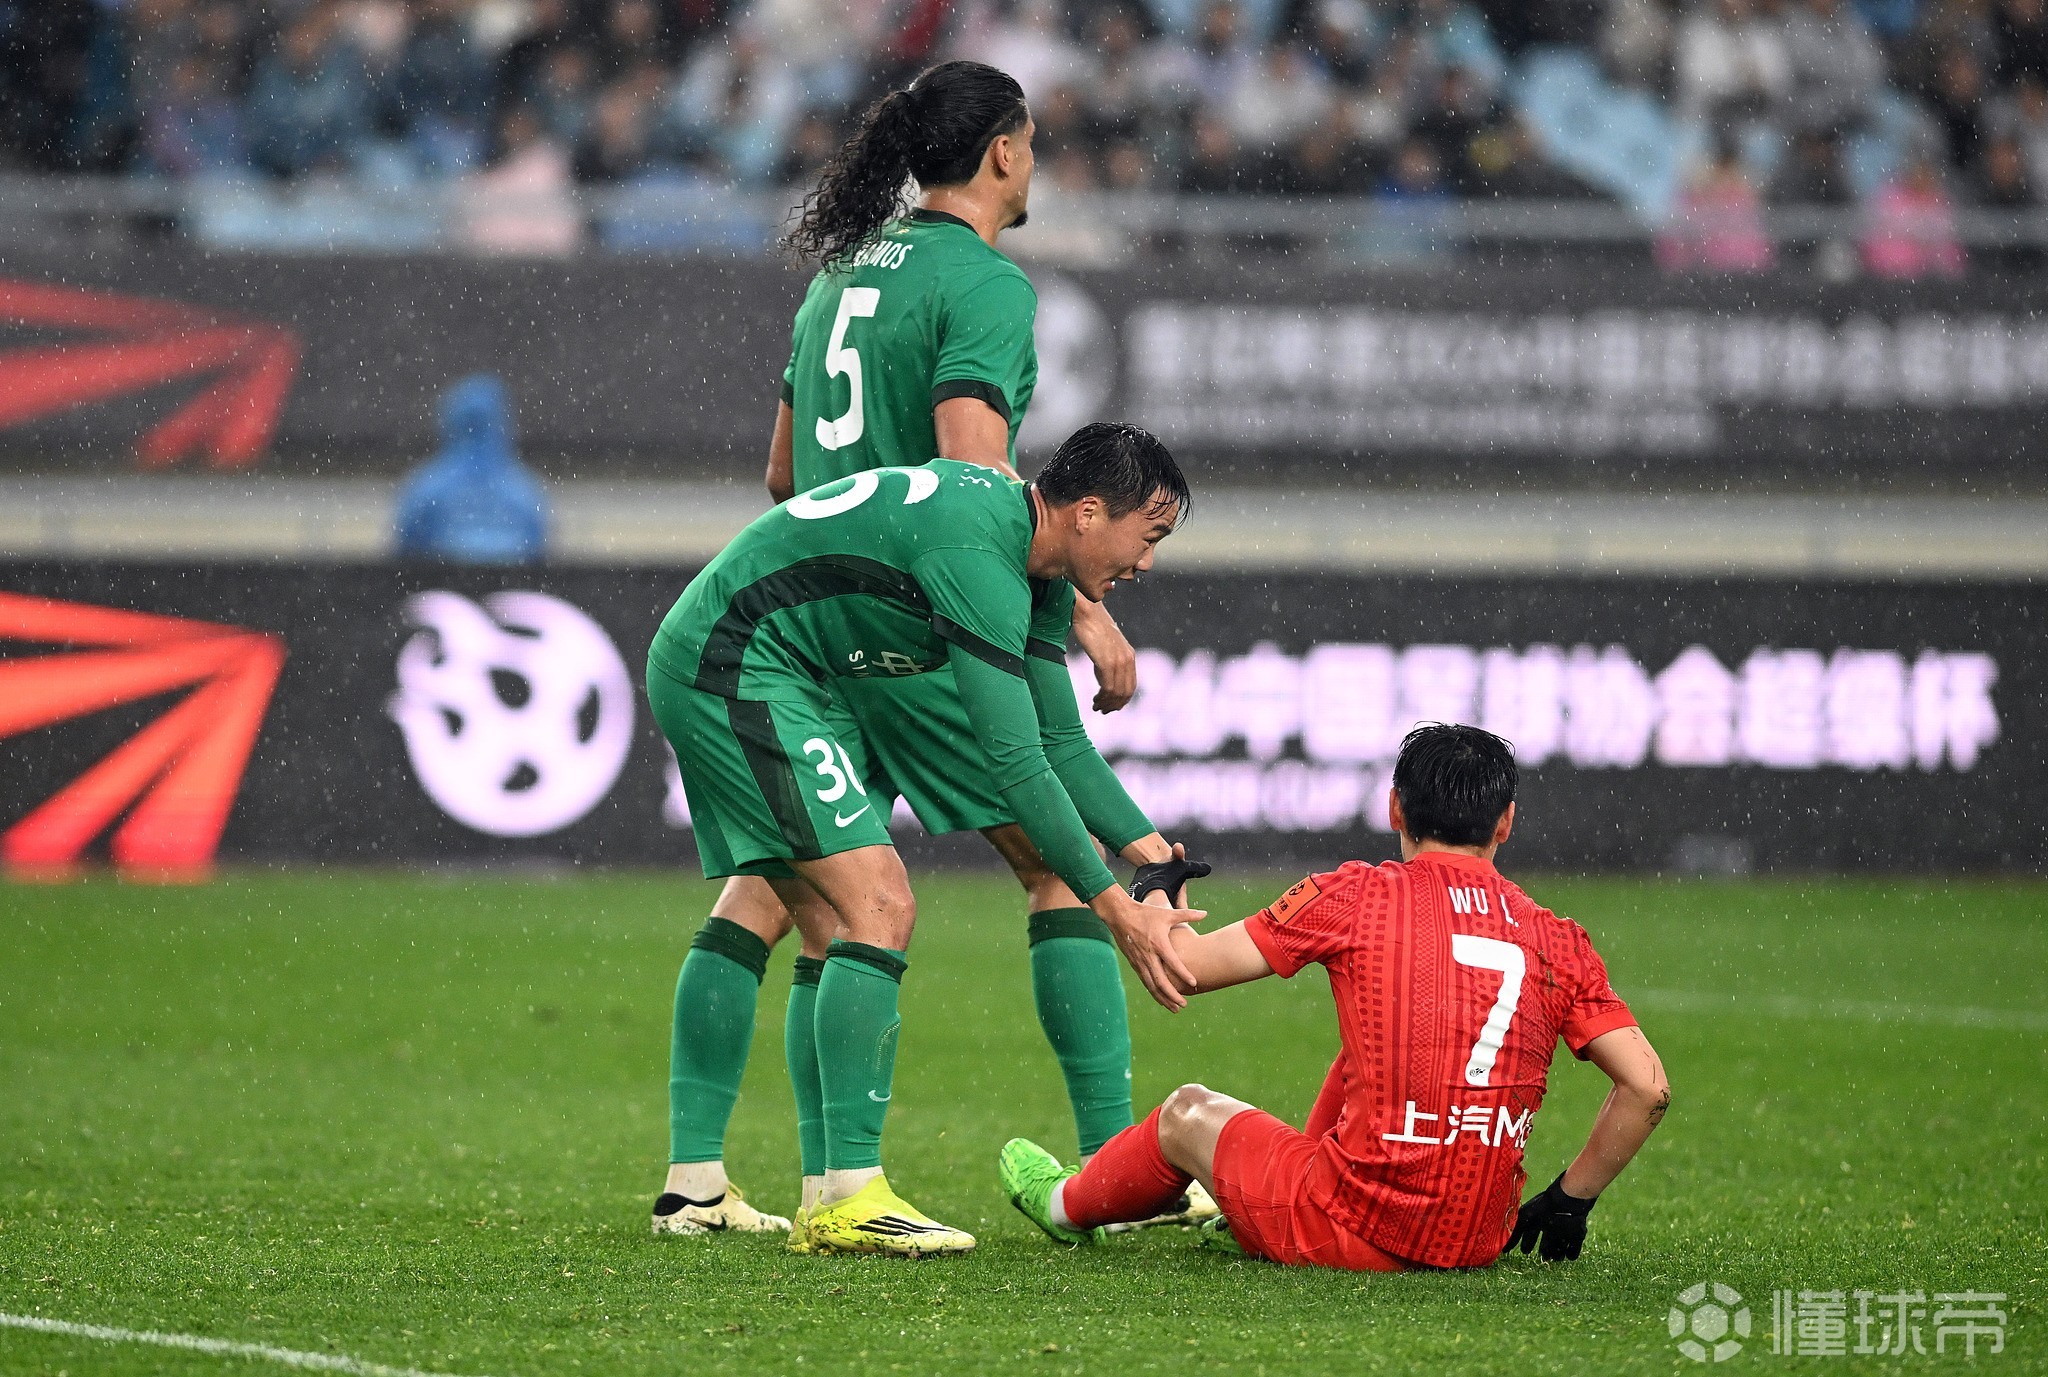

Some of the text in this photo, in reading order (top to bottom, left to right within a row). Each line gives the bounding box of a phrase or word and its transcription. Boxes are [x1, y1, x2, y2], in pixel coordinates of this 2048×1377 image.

[815, 287, 881, 450] 5
[1448, 886, 1489, 915] WU
[1451, 933, 1526, 1087] 7
